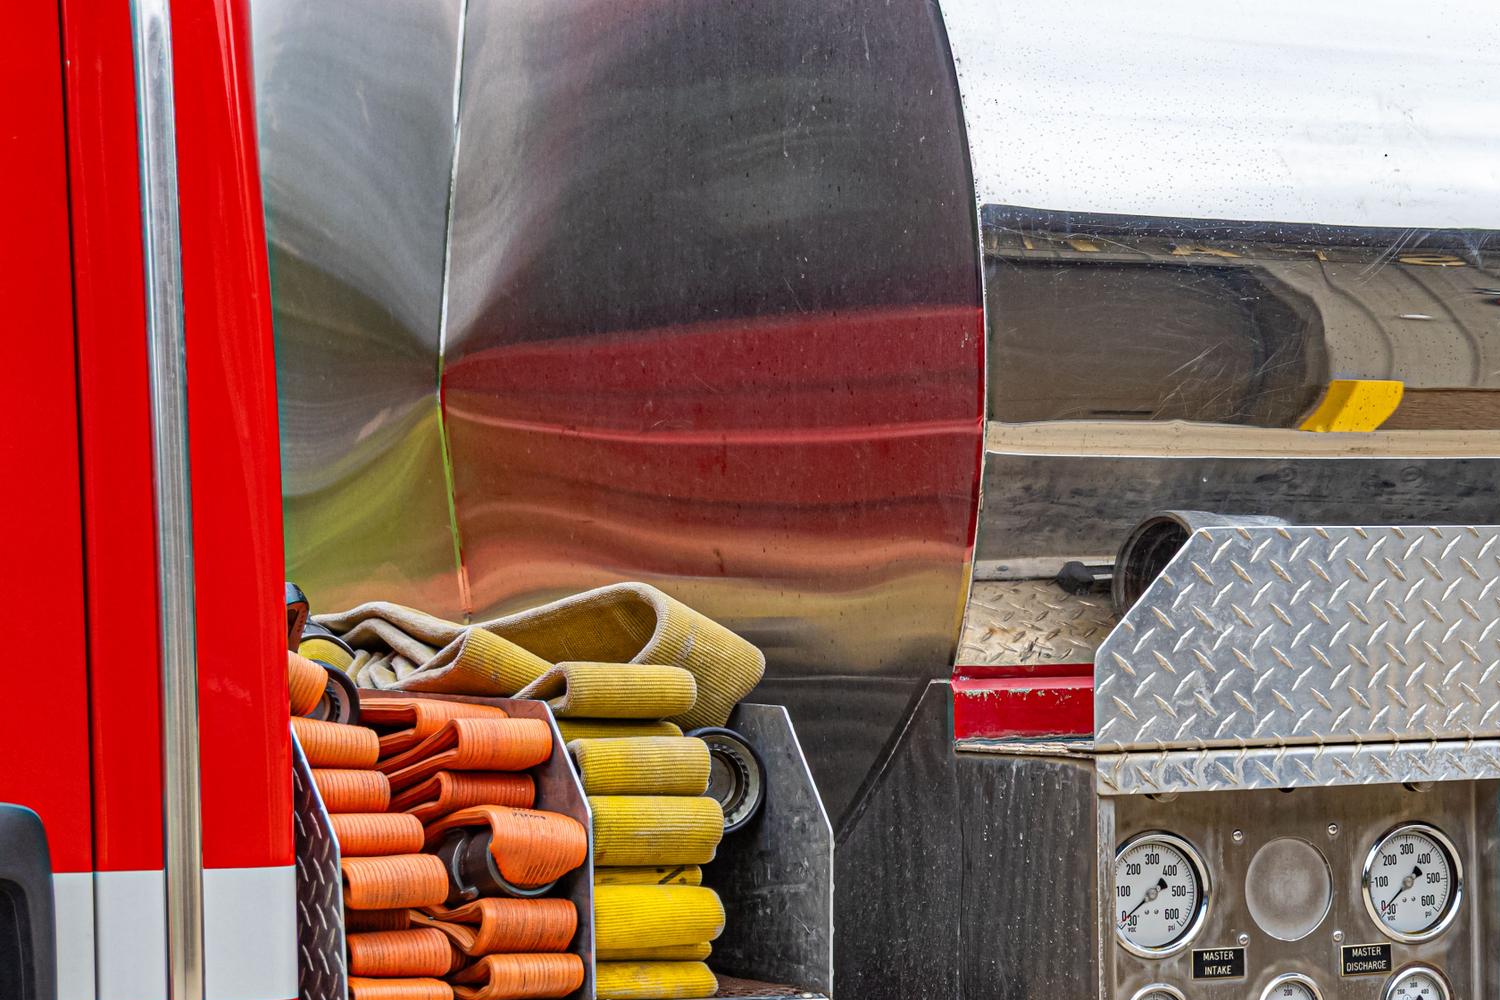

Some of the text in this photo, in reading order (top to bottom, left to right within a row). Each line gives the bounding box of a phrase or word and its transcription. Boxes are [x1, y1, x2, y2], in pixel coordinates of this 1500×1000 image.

[1400, 843, 1414, 855] 300
[1144, 853, 1160, 865] 300
[1383, 854, 1397, 866] 200
[1417, 853, 1431, 864] 400
[1126, 863, 1141, 875] 200
[1162, 865, 1177, 876] 400
[1375, 876, 1388, 887] 100
[1426, 872, 1440, 884] 500
[1116, 885, 1131, 897] 100
[1171, 885, 1186, 897] 500
[1421, 894, 1435, 906] 600
[1164, 908, 1179, 920] 600
[1203, 951, 1234, 961] MASTER
[1352, 947, 1381, 958] MASTER
[1204, 965, 1232, 975] INTAKE
[1346, 960, 1387, 972] DISCHARGE
